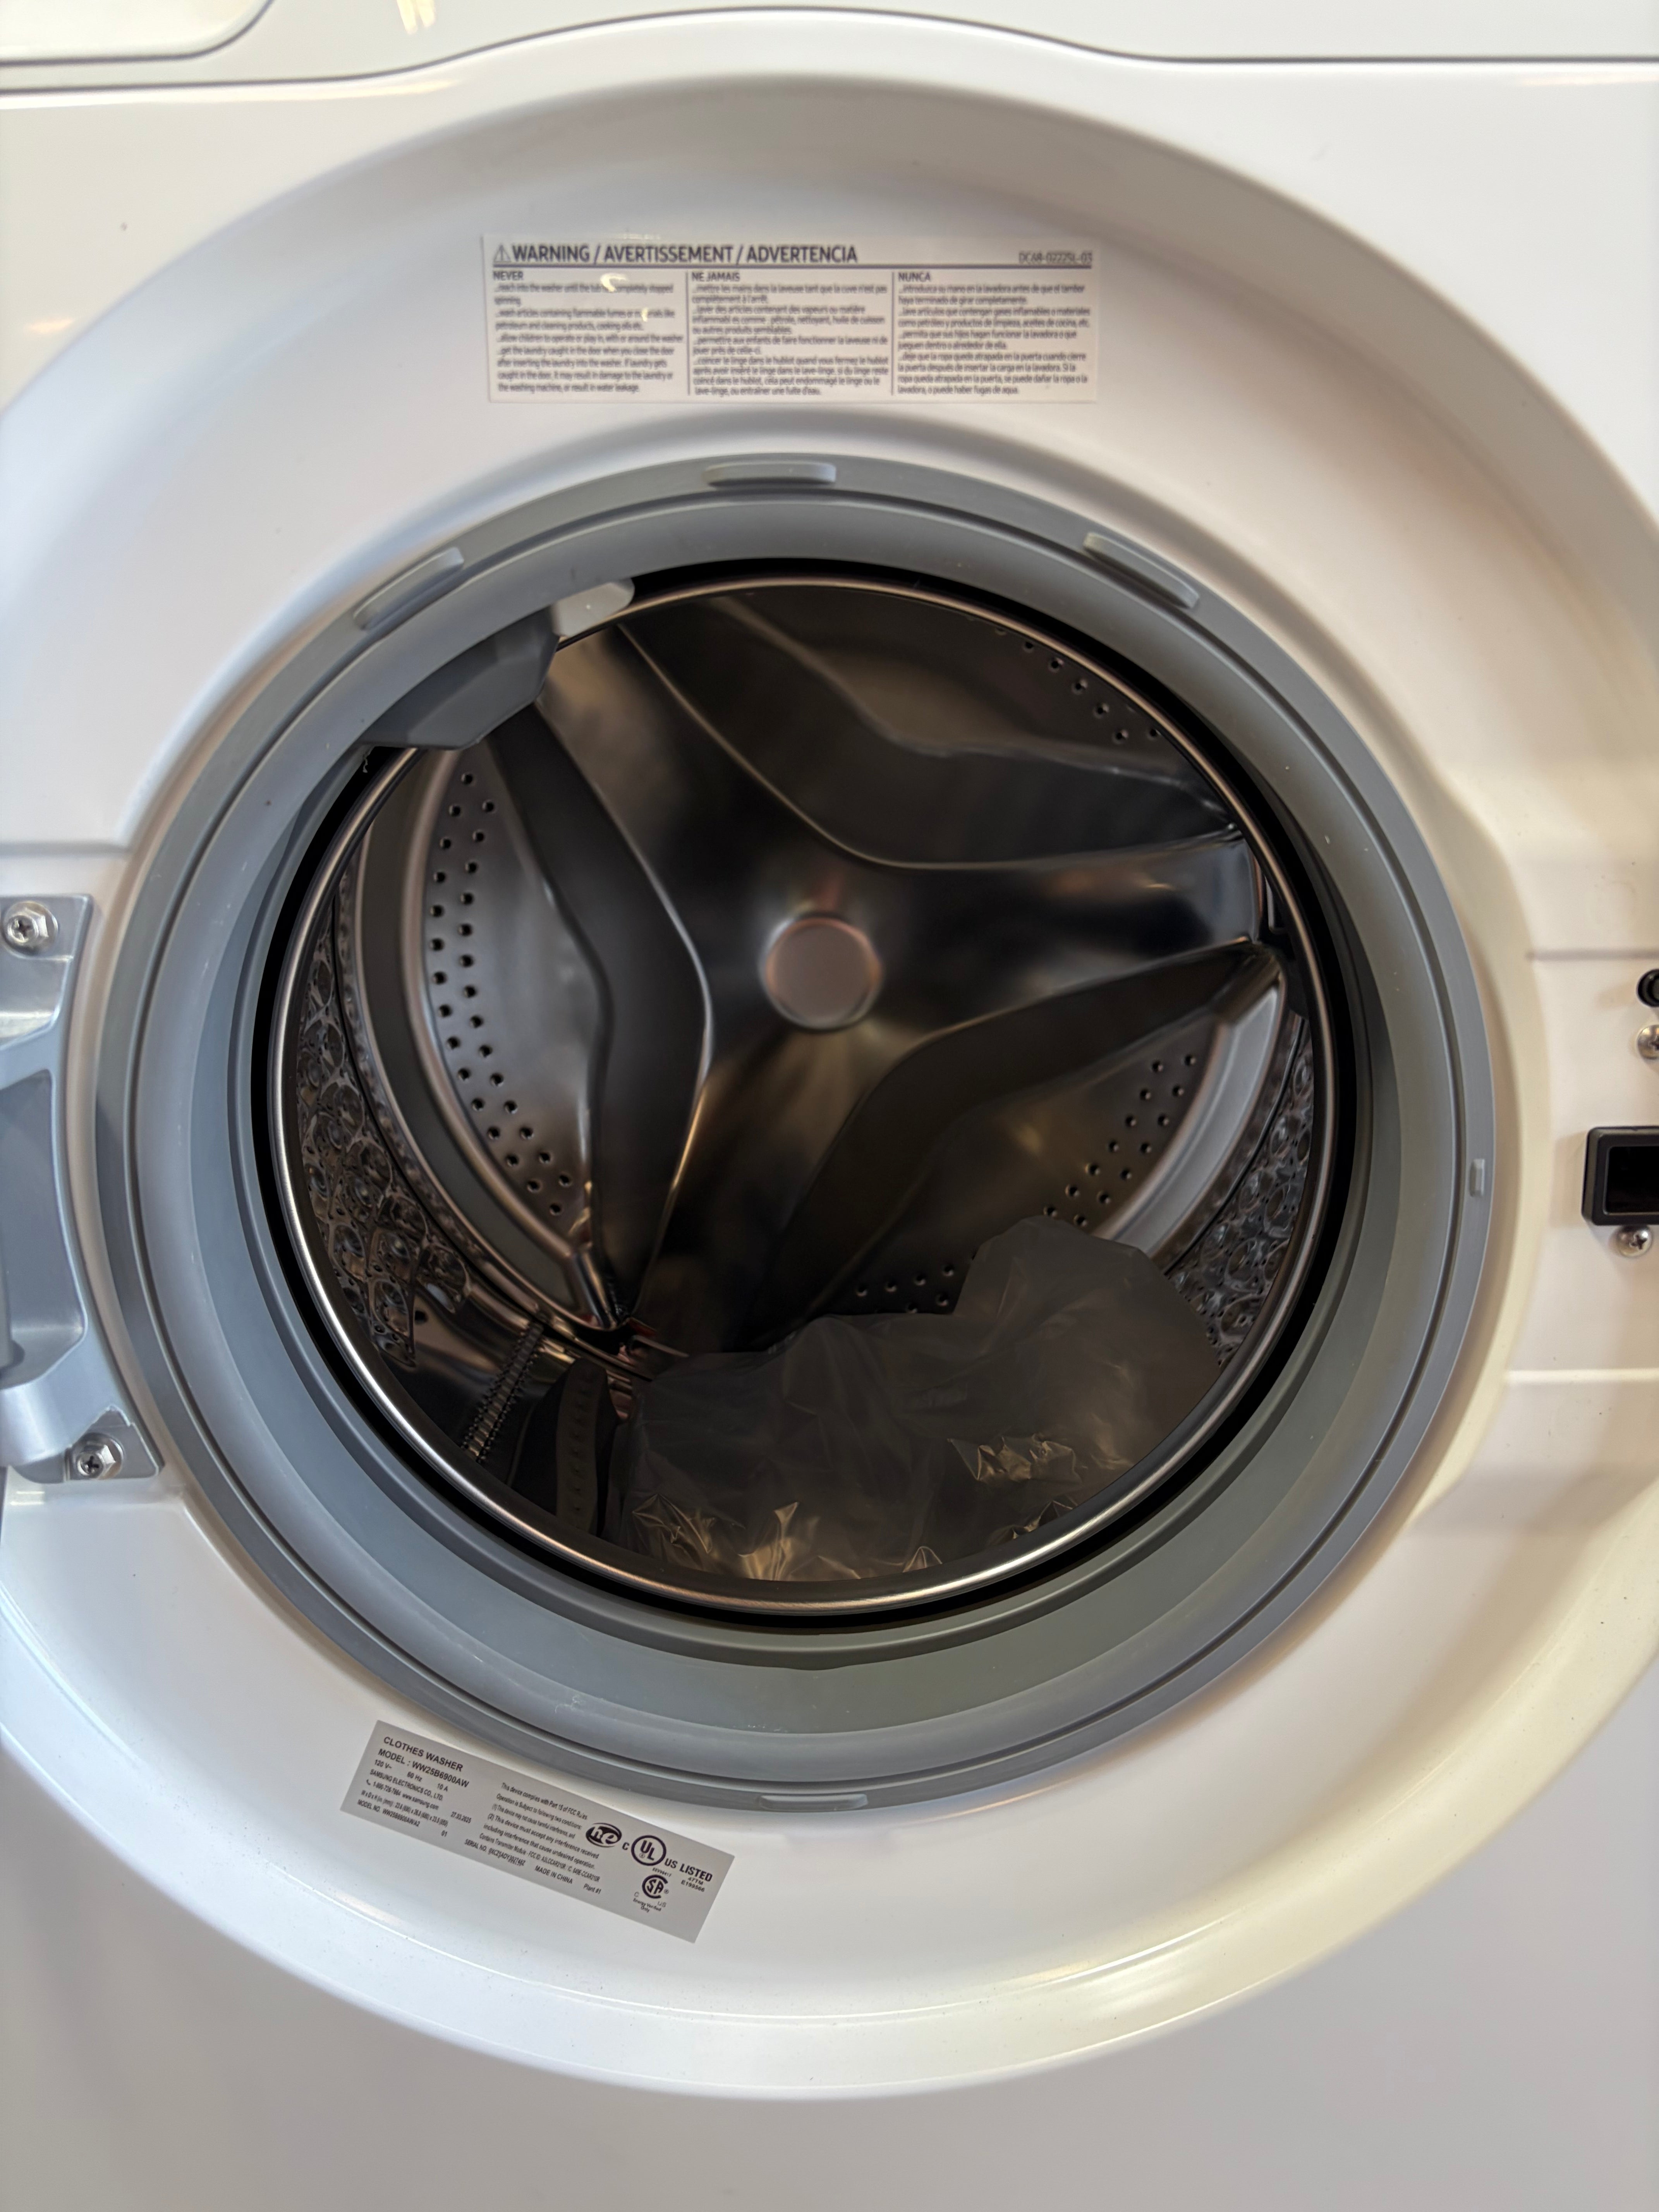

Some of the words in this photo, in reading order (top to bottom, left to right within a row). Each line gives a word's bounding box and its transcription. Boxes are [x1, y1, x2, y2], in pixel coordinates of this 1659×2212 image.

[512, 245, 590, 263] WARNING
[594, 245, 601, 265] /
[604, 246, 733, 263] AVERTISSEMENT
[736, 245, 744, 265] /
[747, 246, 857, 263] ADVERTENCIA
[493, 271, 523, 281] NEVER
[692, 272, 704, 282] NE
[706, 272, 740, 282] JAMAIS
[898, 272, 930, 282] NUNCA
[384, 1736, 424, 1757] CLOTHES
[426, 1752, 463, 1772] WASHER
[378, 1748, 405, 1764] MODEL
[412, 1761, 469, 1787] WW25B6900AW
[370, 1769, 392, 1781] SAMSUNG
[392, 1777, 424, 1793] ELECTRONICS
[501, 1782, 510, 1790] This
[510, 1786, 522, 1795] device
[357, 1799, 372, 1809] MODEL
[402, 1793, 439, 1810] www.samsung.com
[464, 1839, 478, 1849] SERIAL
[483, 1824, 504, 1836] including
[503, 1831, 529, 1844] interference
[552, 1850, 574, 1861] undesired
[495, 1815, 504, 1823] This
[504, 1820, 519, 1829] device
[531, 1830, 546, 1839] accept
[554, 1839, 580, 1852] interference
[580, 1849, 599, 1859] received
[640, 1840, 654, 1861] UL
[664, 1858, 677, 1868] US
[679, 1863, 712, 1881] LISTED
[534, 1865, 550, 1875] MADE
[556, 1874, 572, 1884] CHINA
[688, 1877, 703, 1885] 47TM
[583, 1883, 595, 1892] Plant
[681, 1880, 704, 1892] E199566
